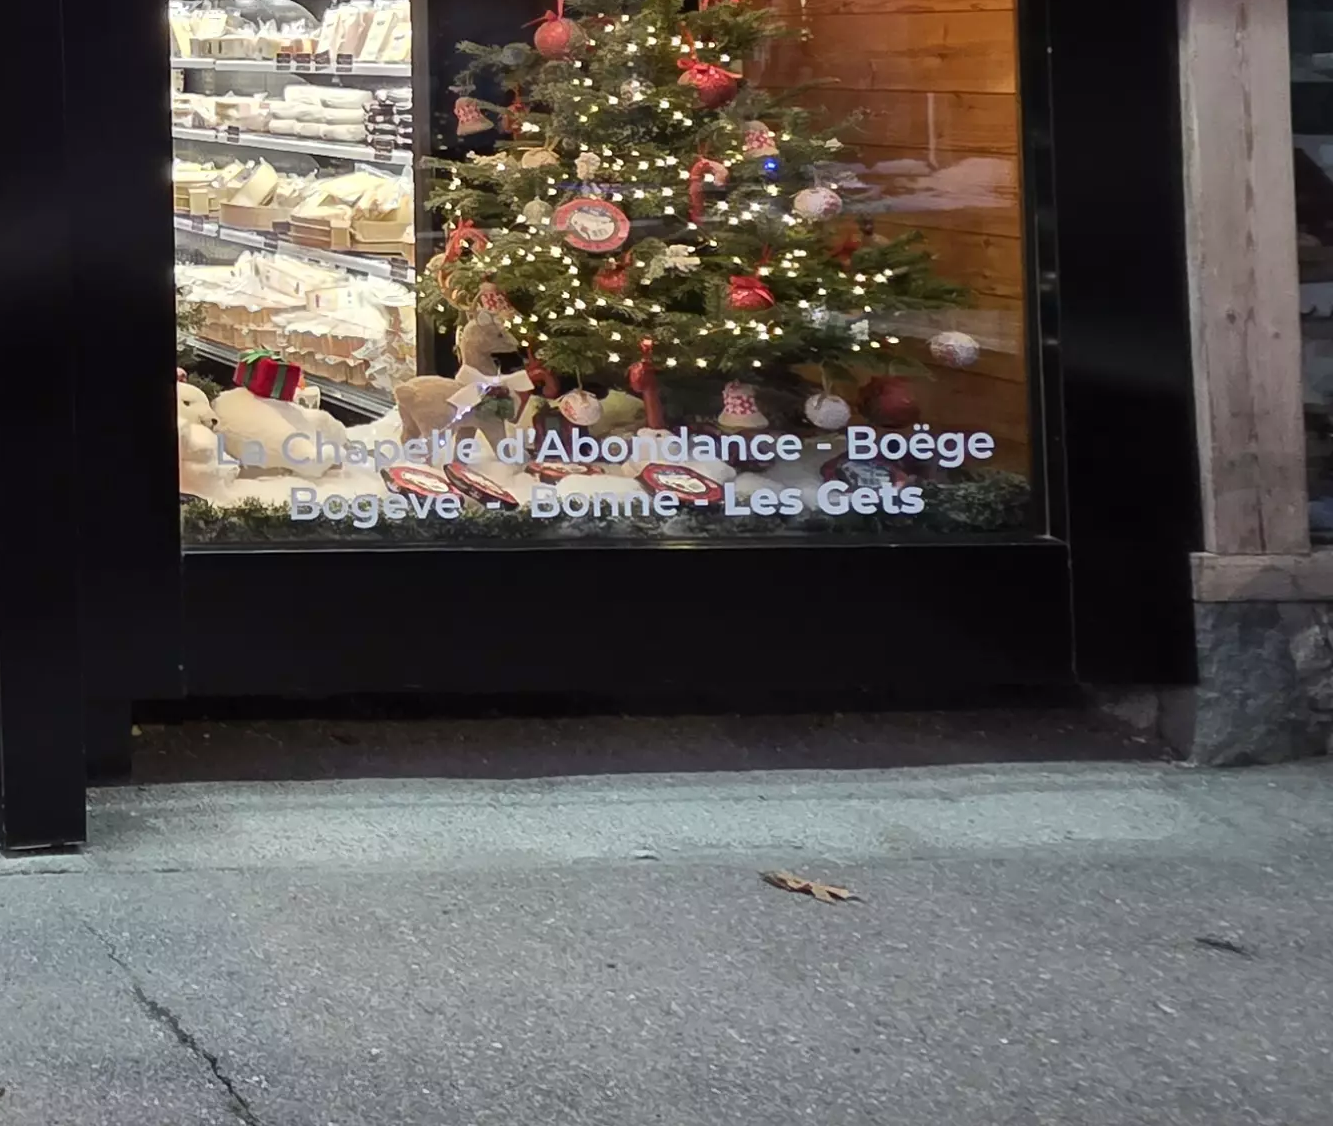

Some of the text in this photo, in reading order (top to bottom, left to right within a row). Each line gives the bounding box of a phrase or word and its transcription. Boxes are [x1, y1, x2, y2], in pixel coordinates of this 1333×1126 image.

[216, 433, 266, 466] La
[281, 430, 482, 475] Chapelle
[496, 427, 803, 466] d'Abondance
[847, 424, 996, 469] Boëge
[531, 487, 680, 519] Bonne
[724, 482, 805, 517] Les
[816, 480, 925, 517] Gets
